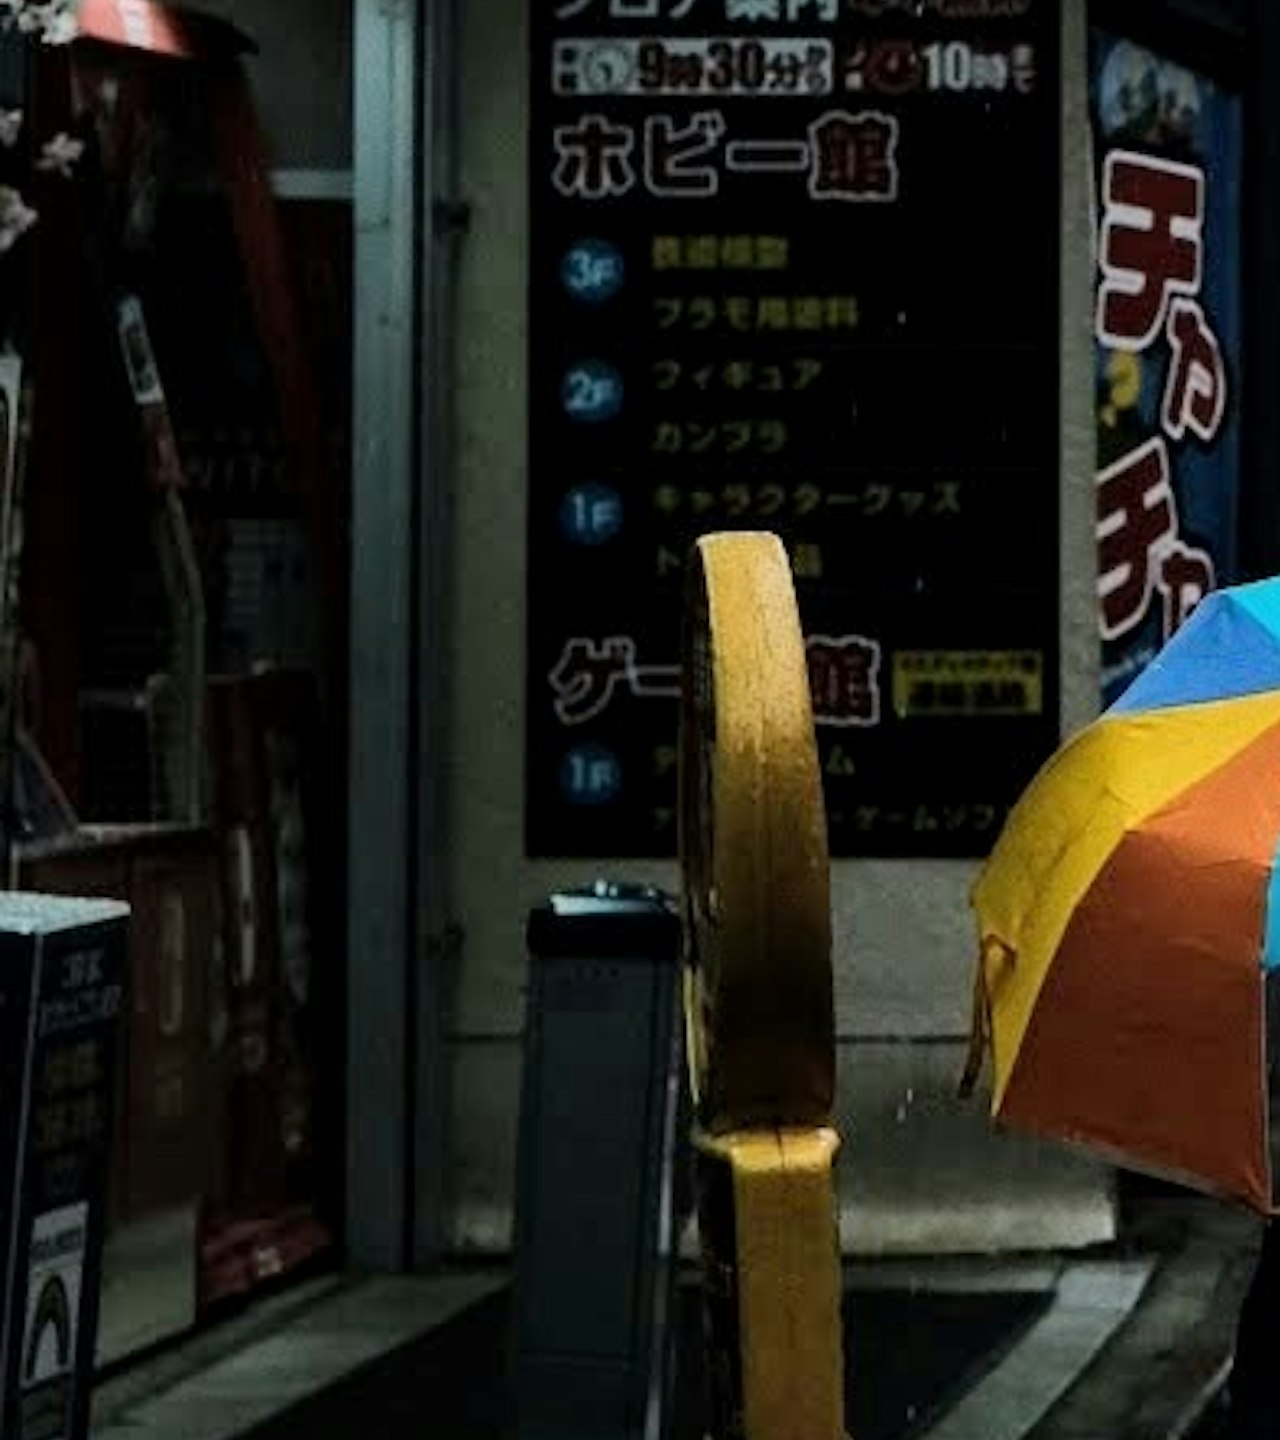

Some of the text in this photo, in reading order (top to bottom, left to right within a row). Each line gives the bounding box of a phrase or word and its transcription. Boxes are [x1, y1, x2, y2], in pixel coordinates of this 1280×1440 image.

[551, 109, 901, 203] ホビー館
[547, 633, 882, 727] ゲー館
